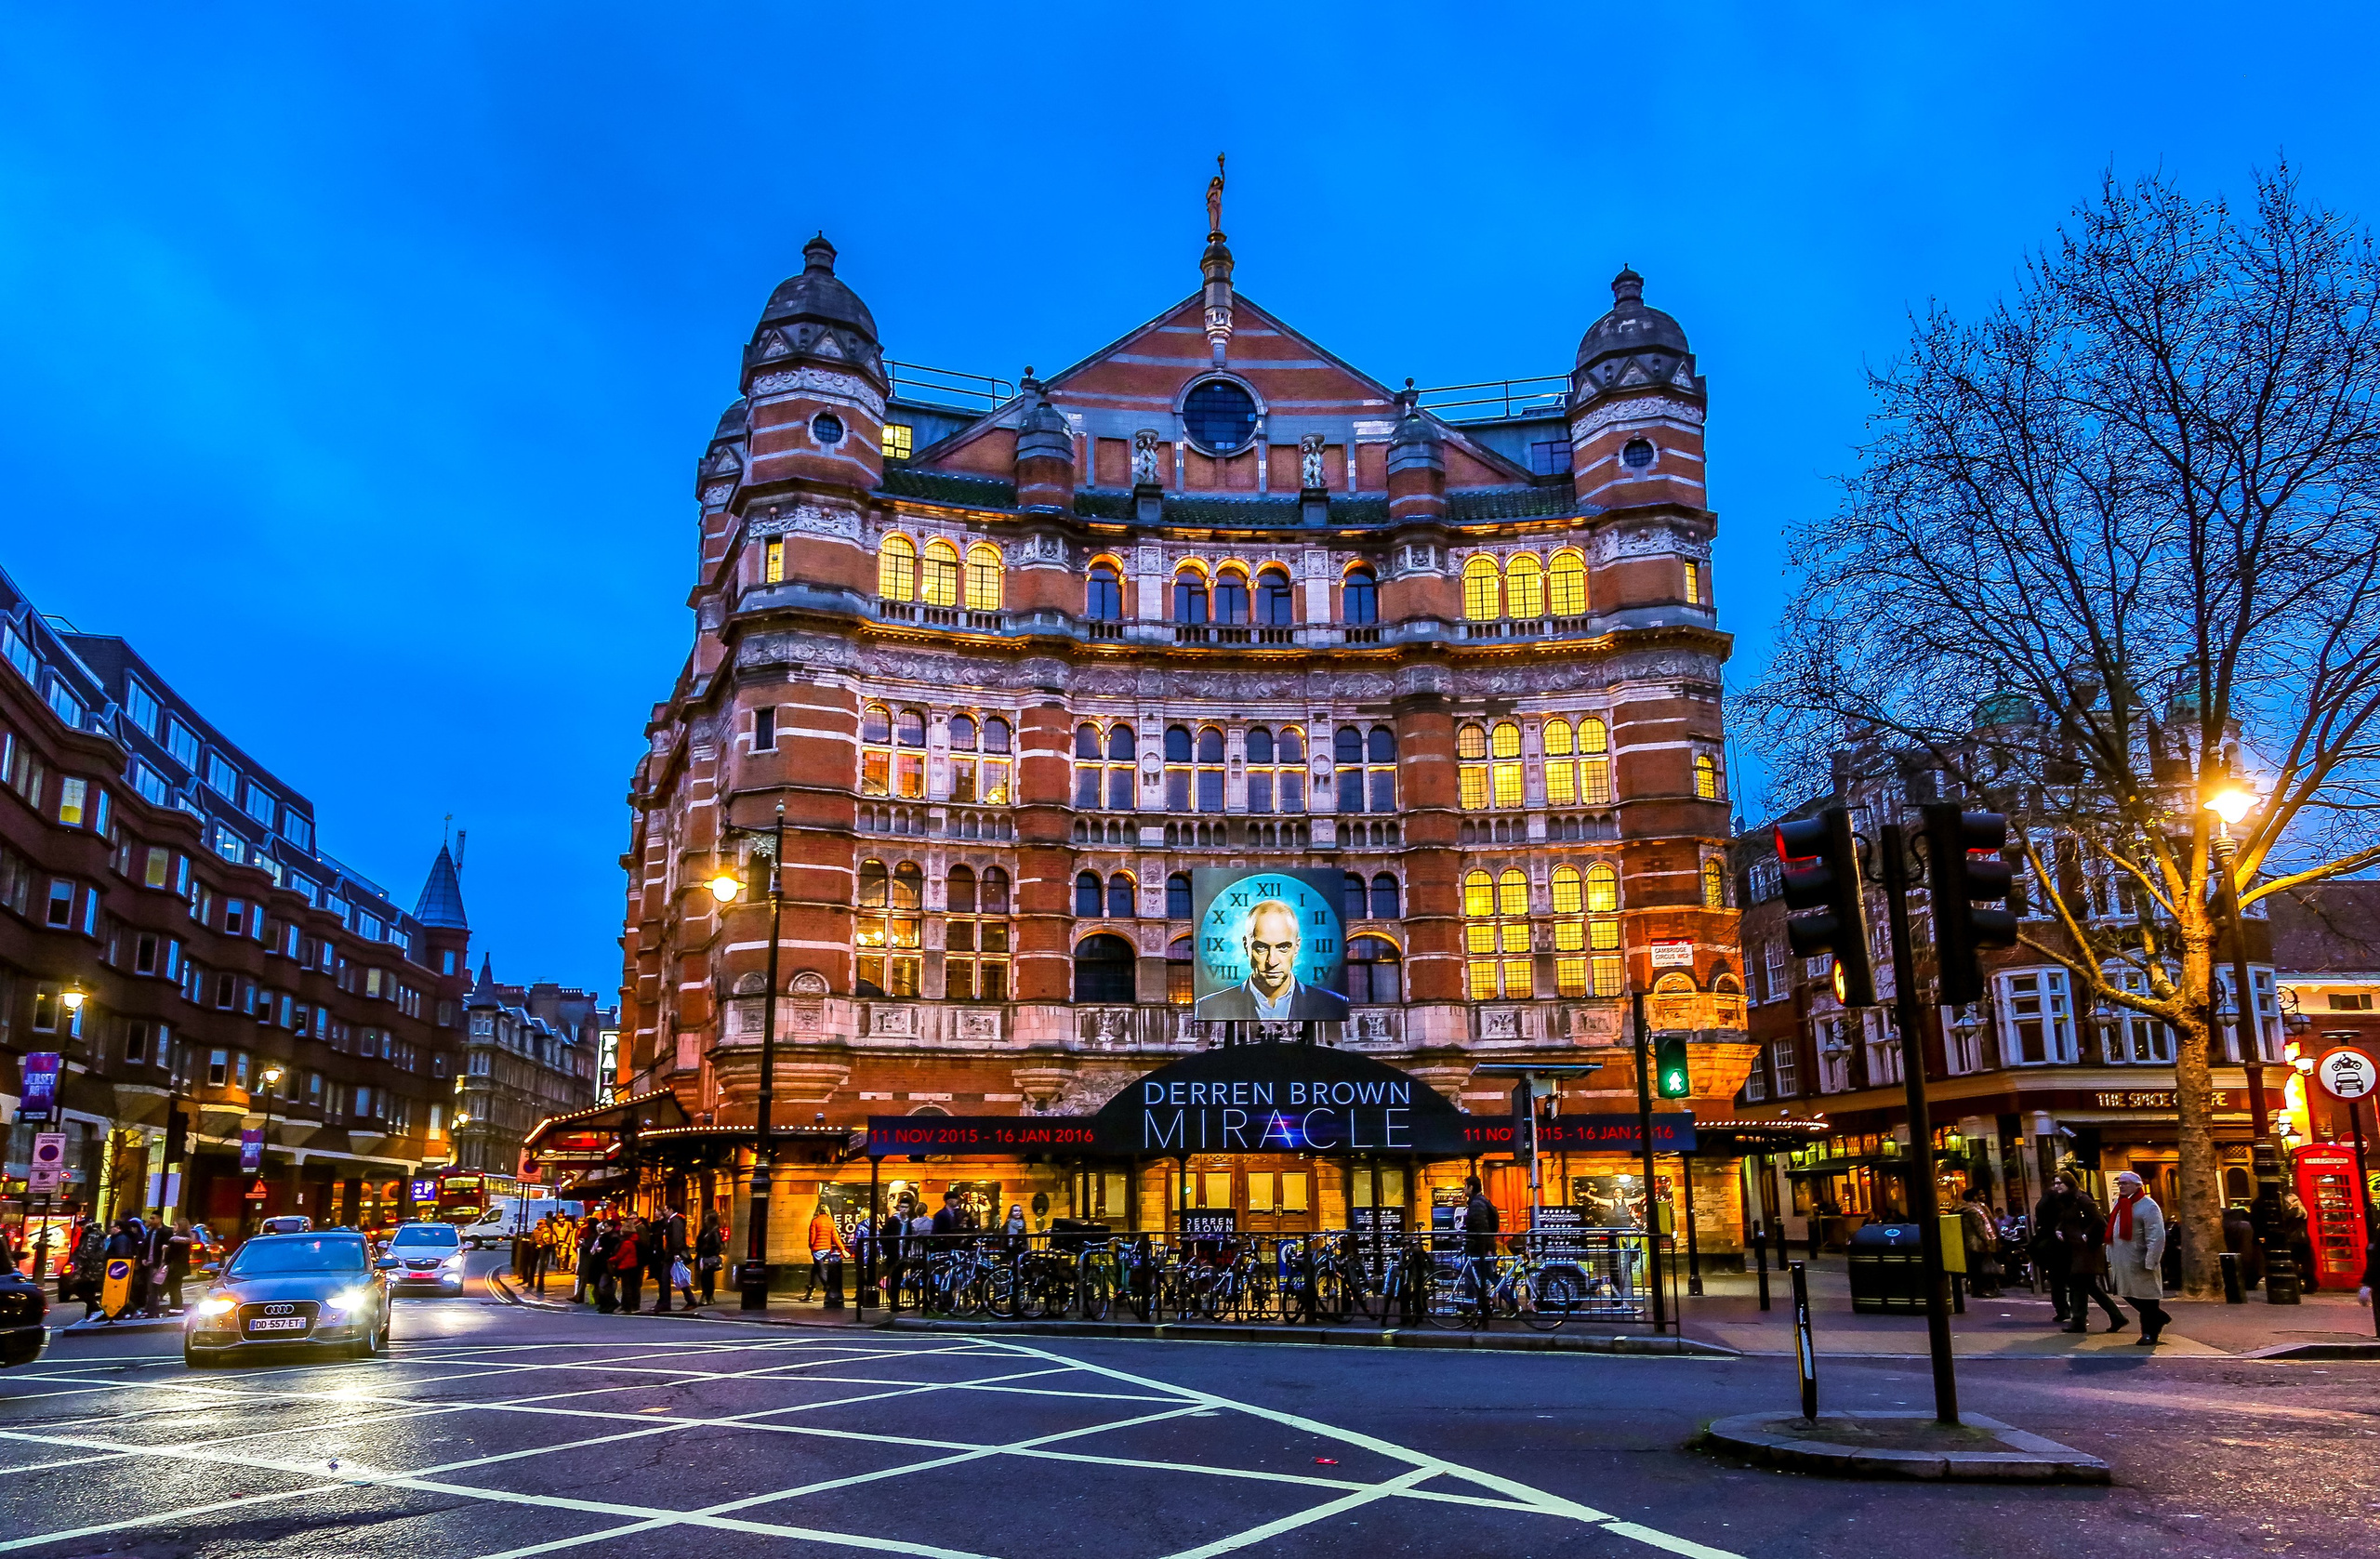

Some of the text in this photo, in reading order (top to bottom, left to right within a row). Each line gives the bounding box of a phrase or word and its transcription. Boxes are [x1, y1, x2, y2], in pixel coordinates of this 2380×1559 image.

[1257, 883, 1281, 896] XII
[1230, 893, 1249, 906] XI
[1299, 893, 1305, 906] I
[1212, 910, 1225, 924] X
[1314, 911, 1327, 925] II
[1206, 937, 1224, 952] IX
[1315, 938, 1334, 953] III
[1207, 966, 1239, 980] VIII
[1313, 966, 1331, 981] IV
[1144, 1081, 1410, 1104] DERREN BROWN
[2096, 1092, 2126, 1107] THE
[2129, 1092, 2171, 1107] SPICE
[1145, 1108, 1412, 1148] MIRACLE
[1463, 1129, 1480, 1142] 11
[1537, 1127, 1563, 1141] 015
[1578, 1127, 1595, 1140] 16
[1600, 1127, 1630, 1140] JAN
[1635, 1126, 1673, 1140] 216
[871, 1130, 888, 1143] 11
[895, 1130, 933, 1143] NOV
[938, 1129, 978, 1143] 2015
[995, 1129, 1013, 1143] 16
[1018, 1129, 1050, 1143] JAN
[1055, 1129, 1093, 1143] 2016
